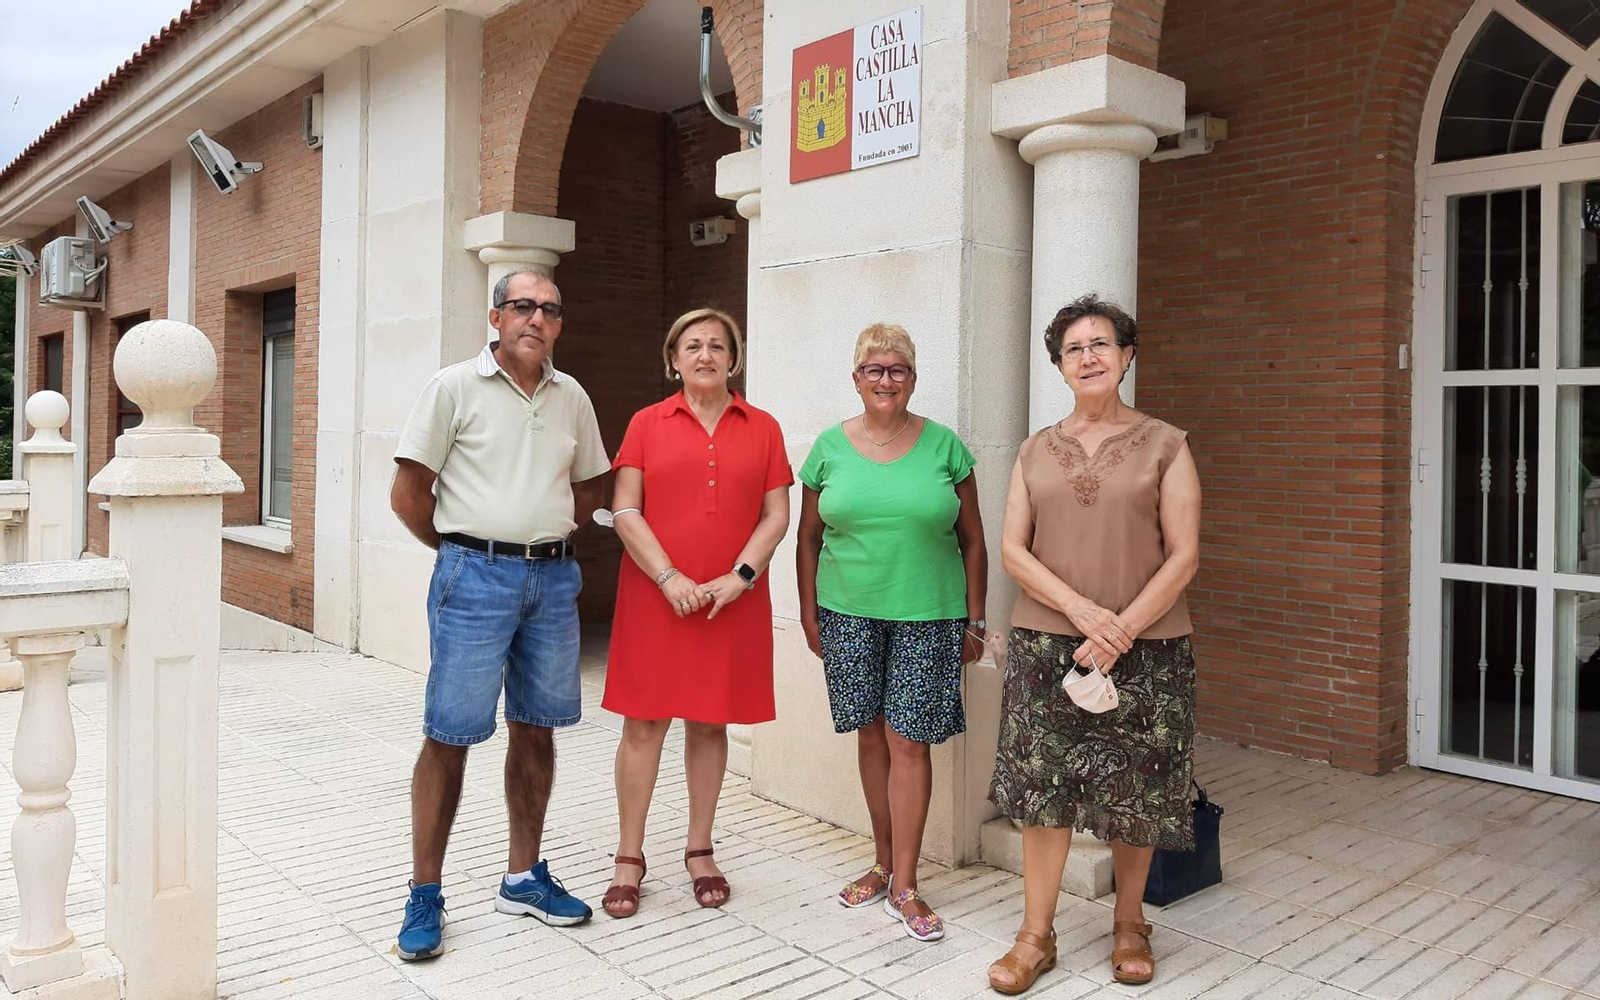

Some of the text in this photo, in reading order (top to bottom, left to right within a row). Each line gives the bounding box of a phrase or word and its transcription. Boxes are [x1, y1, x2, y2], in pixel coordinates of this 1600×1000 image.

[871, 18, 904, 50] CASA
[856, 41, 919, 81] CASTILLA
[878, 76, 895, 103] LA
[858, 100, 914, 136] MANCHA
[858, 149, 886, 162] Fundada
[897, 142, 913, 154] 2003
